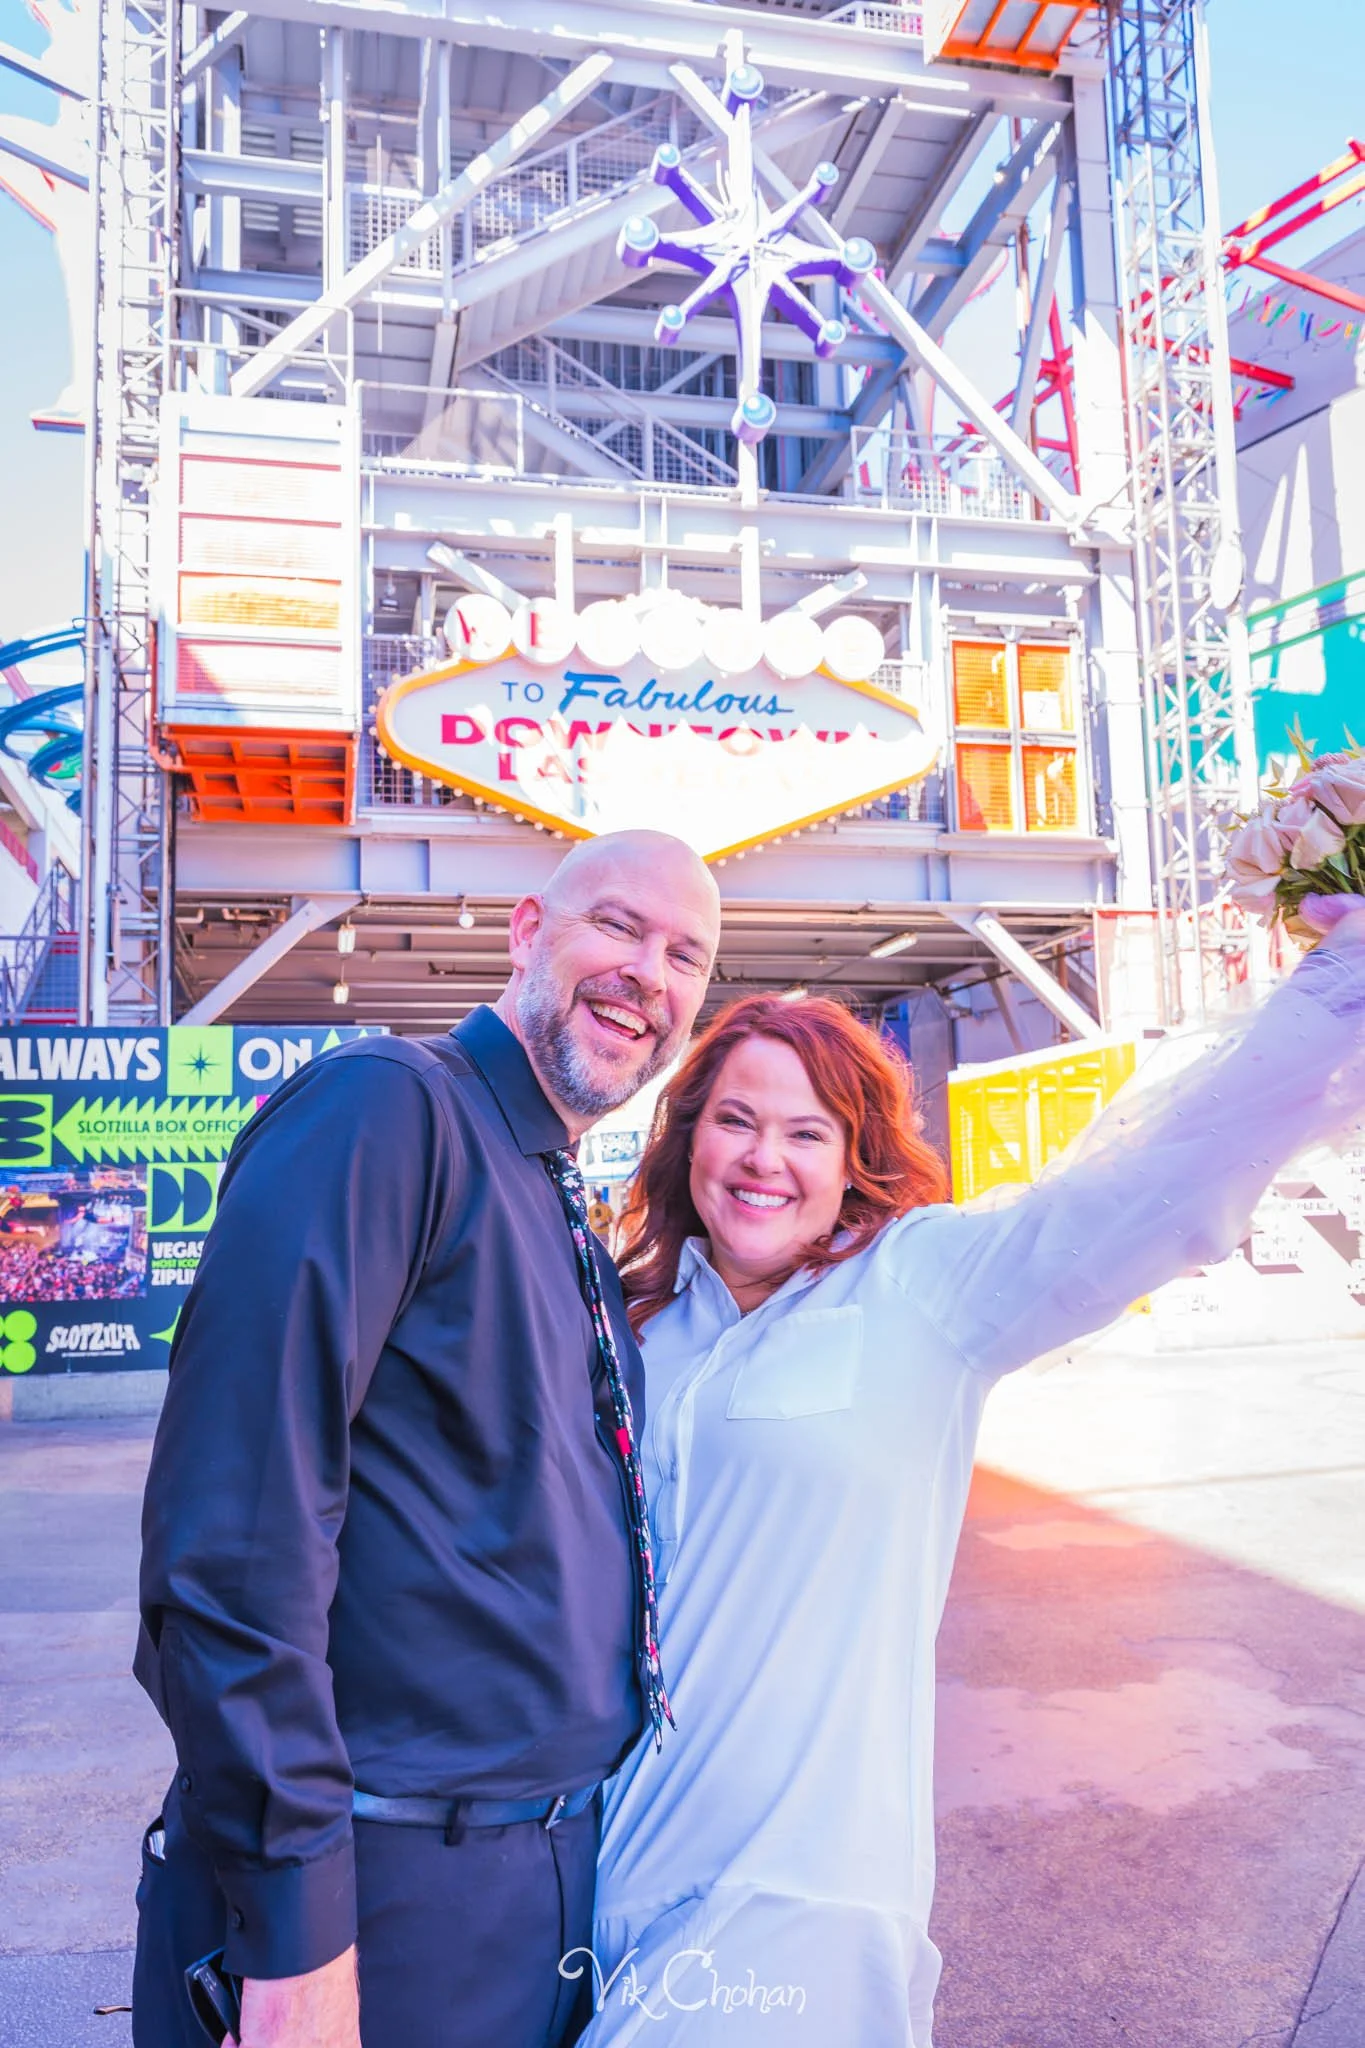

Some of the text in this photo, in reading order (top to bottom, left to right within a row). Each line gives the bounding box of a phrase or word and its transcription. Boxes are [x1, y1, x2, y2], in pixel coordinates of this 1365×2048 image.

[502, 671, 794, 716] TO Fabulous
[0, 1037, 312, 1081] ALWAYS ON
[77, 1120, 150, 1133] SLOTZILLA
[156, 1120, 187, 1133] BOX
